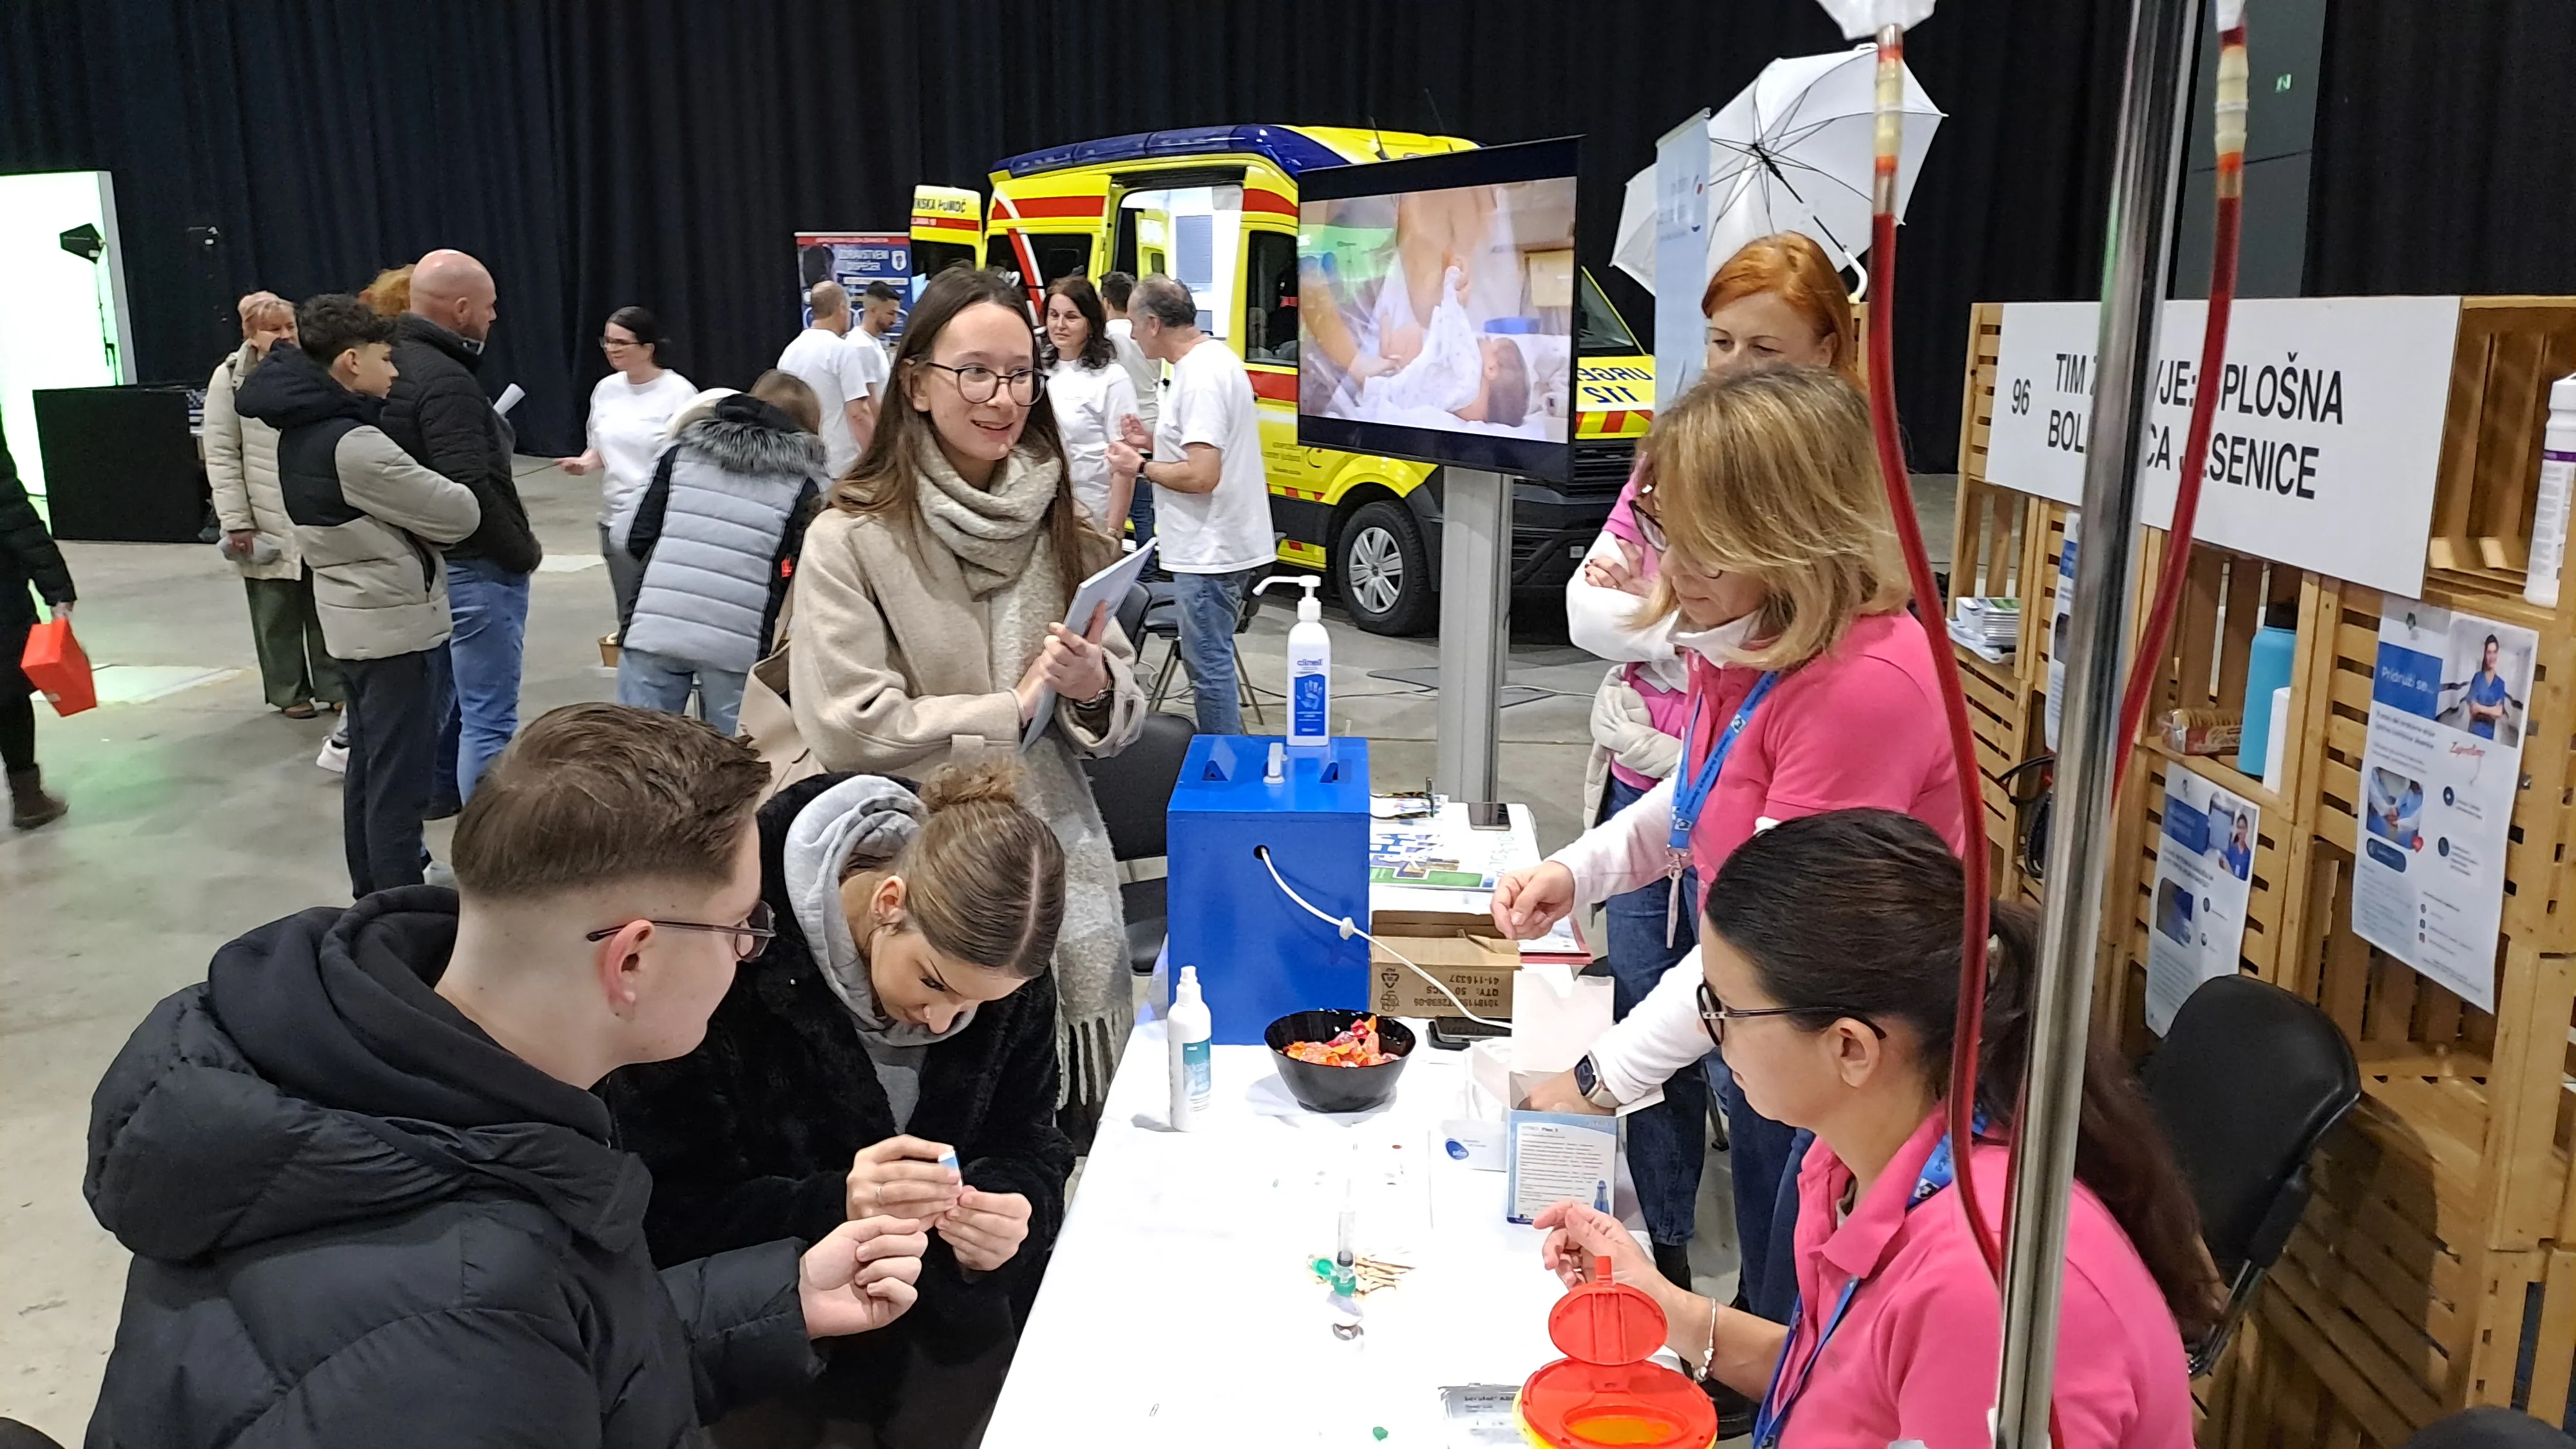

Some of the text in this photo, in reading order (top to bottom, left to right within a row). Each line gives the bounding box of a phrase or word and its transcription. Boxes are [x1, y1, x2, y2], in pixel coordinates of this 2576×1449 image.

[2011, 378, 2031, 415] 96
[2056, 353, 2087, 394] TIM
[2217, 352, 2343, 425] PLOŠNA
[2179, 432, 2320, 500] SENICE
[1455, 987, 1467, 996] 50
